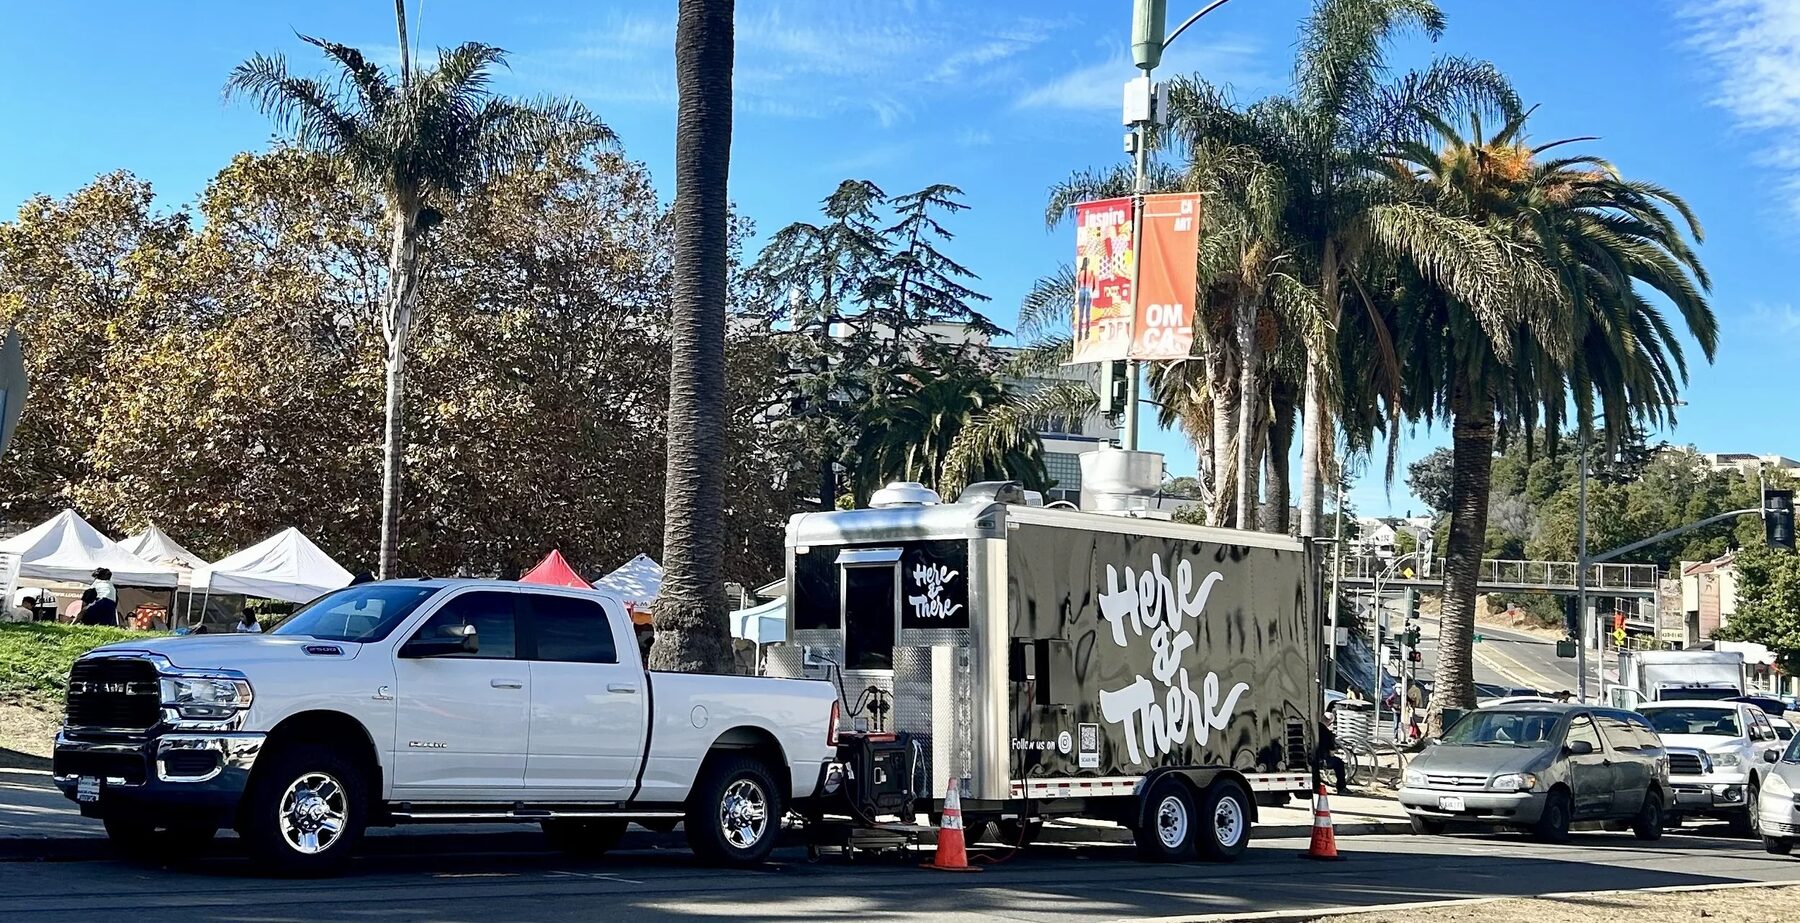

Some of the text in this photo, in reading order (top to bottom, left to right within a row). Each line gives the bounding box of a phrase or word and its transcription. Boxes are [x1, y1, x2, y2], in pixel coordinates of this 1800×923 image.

[1085, 206, 1126, 228] inspire
[1146, 304, 1183, 328] OM
[913, 563, 959, 587] Here
[928, 582, 944, 600] &
[1099, 553, 1223, 647] Here
[909, 595, 963, 619] There
[1150, 620, 1194, 686] &
[1100, 668, 1249, 765] There
[1012, 737, 1056, 750] Follow us on
